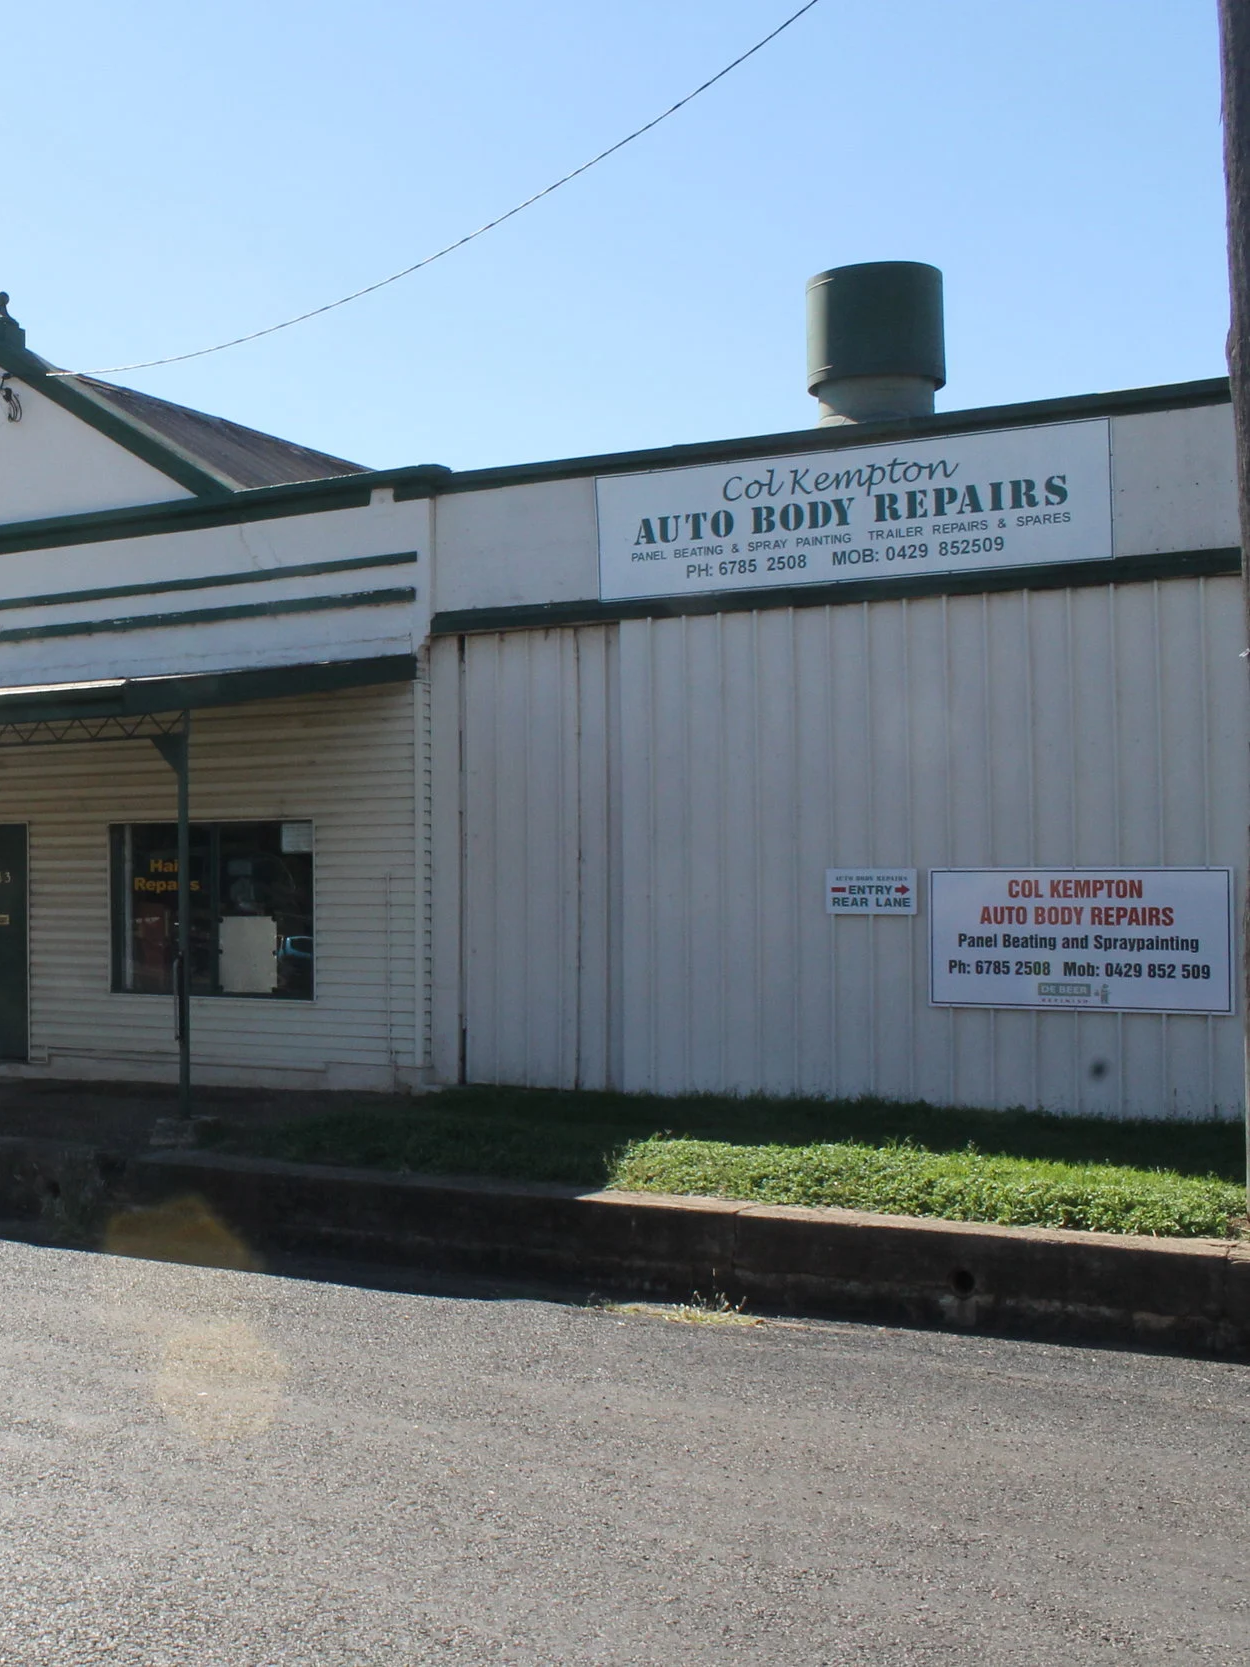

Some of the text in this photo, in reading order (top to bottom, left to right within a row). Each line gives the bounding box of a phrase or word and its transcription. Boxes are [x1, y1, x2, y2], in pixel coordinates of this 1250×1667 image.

[723, 457, 959, 501] Col Kempton
[633, 474, 1069, 545] AUTO BODY REPAIRS
[631, 512, 1071, 562] PANEL BEATING & SPRAY PAINTING TRAILER REPAIRS & SPARES
[686, 536, 1005, 579] PH: 6785 2508 MOB: 0429 852509
[150, 859, 178, 873] Hai
[134, 877, 200, 894] Repas
[849, 885, 892, 895] ENTRY
[1008, 879, 1143, 899] COL KEMPTON
[832, 897, 911, 908] REAR LANE
[980, 906, 1174, 927] AUTO BODY REPAIRS
[958, 933, 1199, 953] Panel Beating and Spraypainting
[949, 959, 1210, 980] Ph: 6785 2508 Mob: 0429 852 509
[1041, 985, 1087, 995] DE BEER
